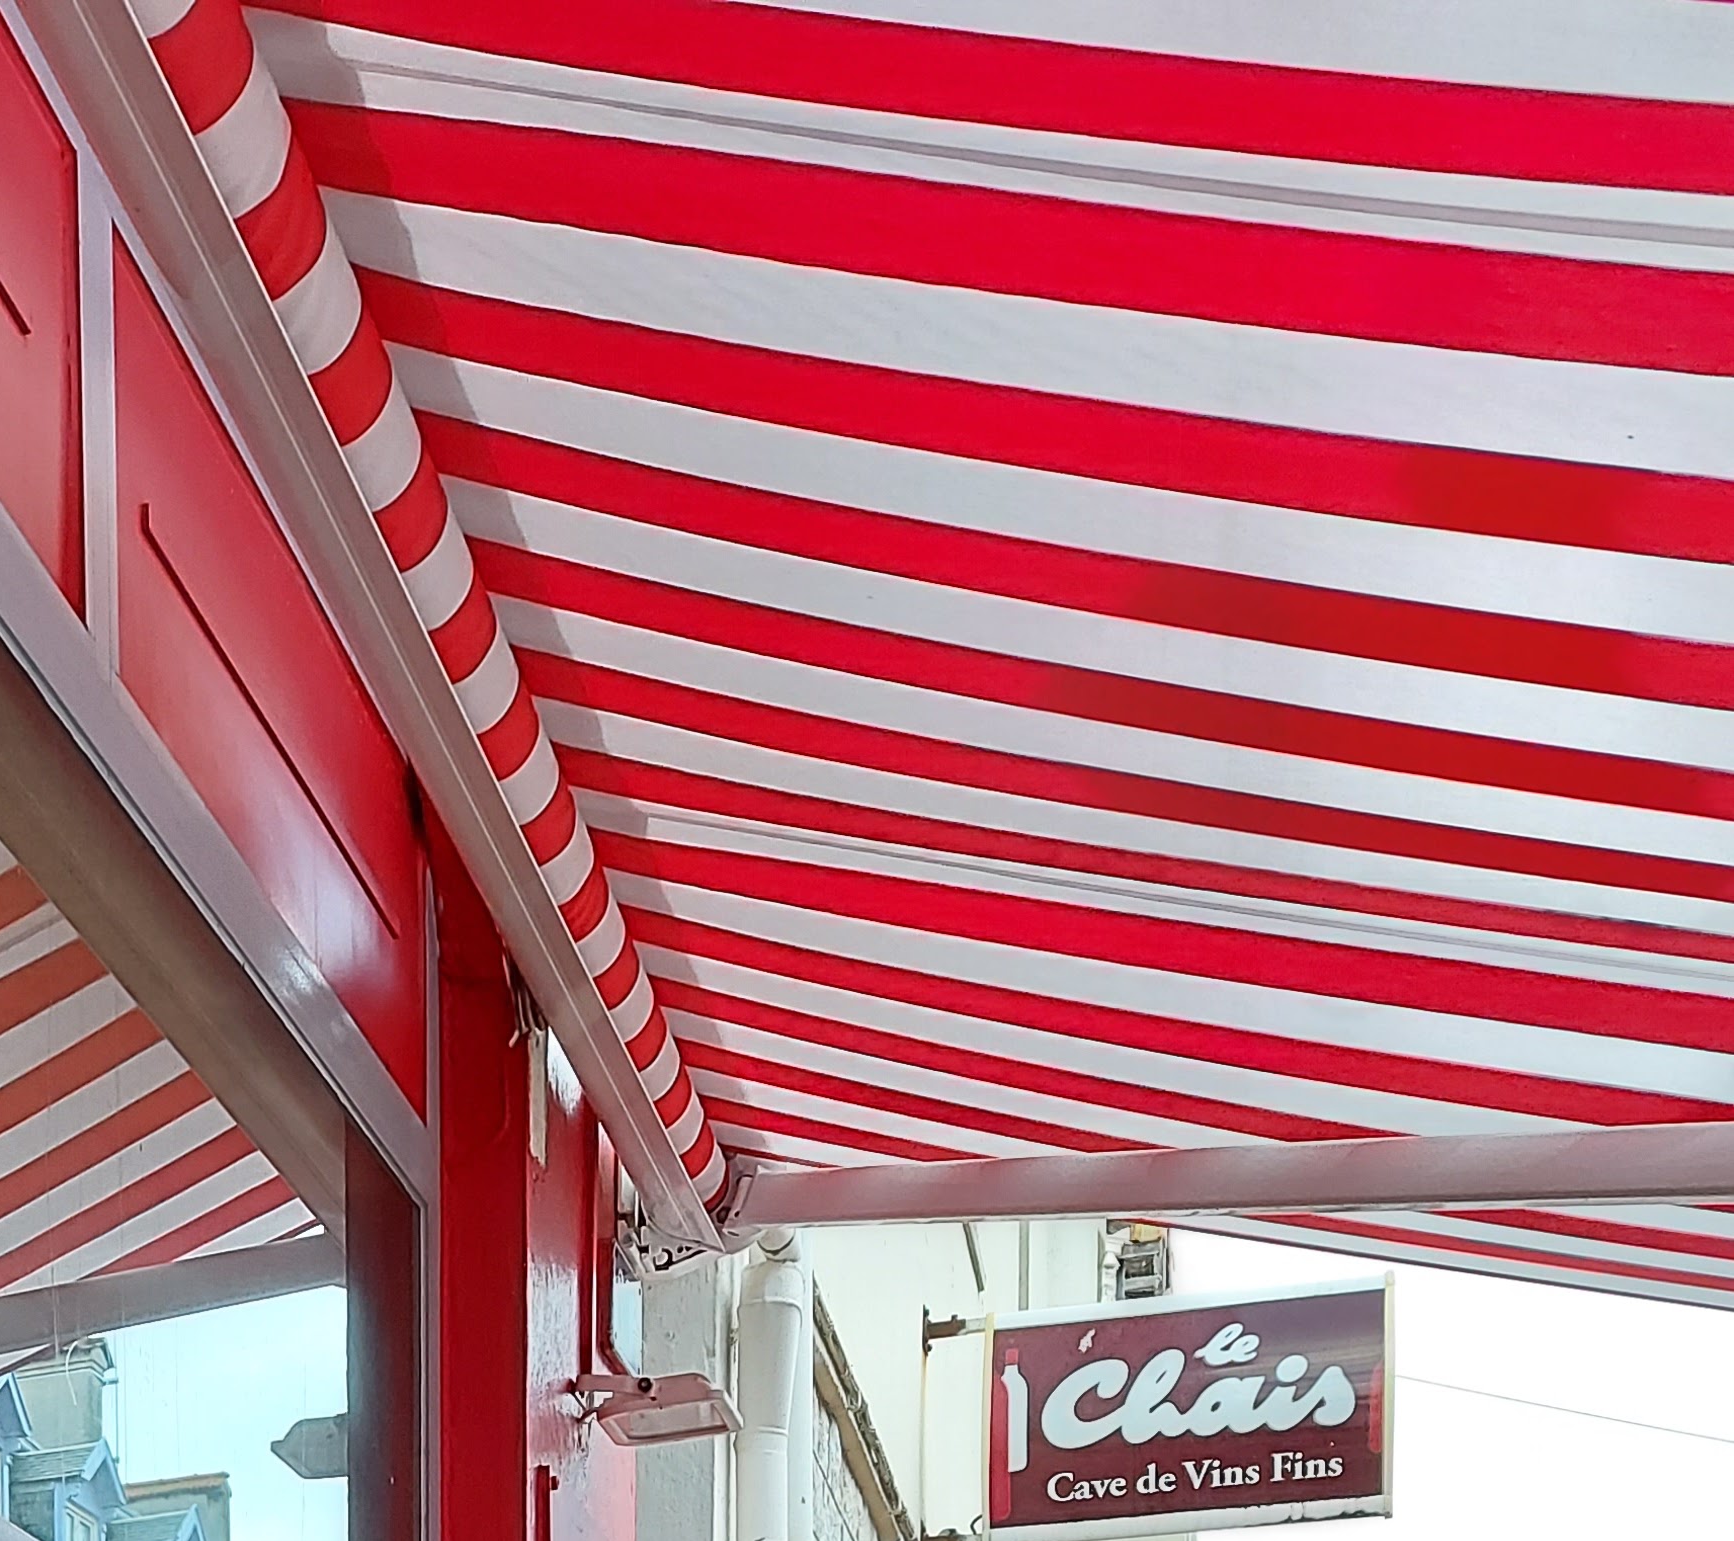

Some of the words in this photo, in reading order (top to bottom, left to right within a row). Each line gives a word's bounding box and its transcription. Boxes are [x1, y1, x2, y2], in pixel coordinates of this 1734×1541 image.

[1193, 1322, 1261, 1367] le
[1040, 1348, 1357, 1450] Chais
[1046, 1472, 1129, 1504] Cave
[1135, 1463, 1178, 1494] de
[1182, 1455, 1262, 1491] Vins
[1269, 1449, 1344, 1482] Fins
